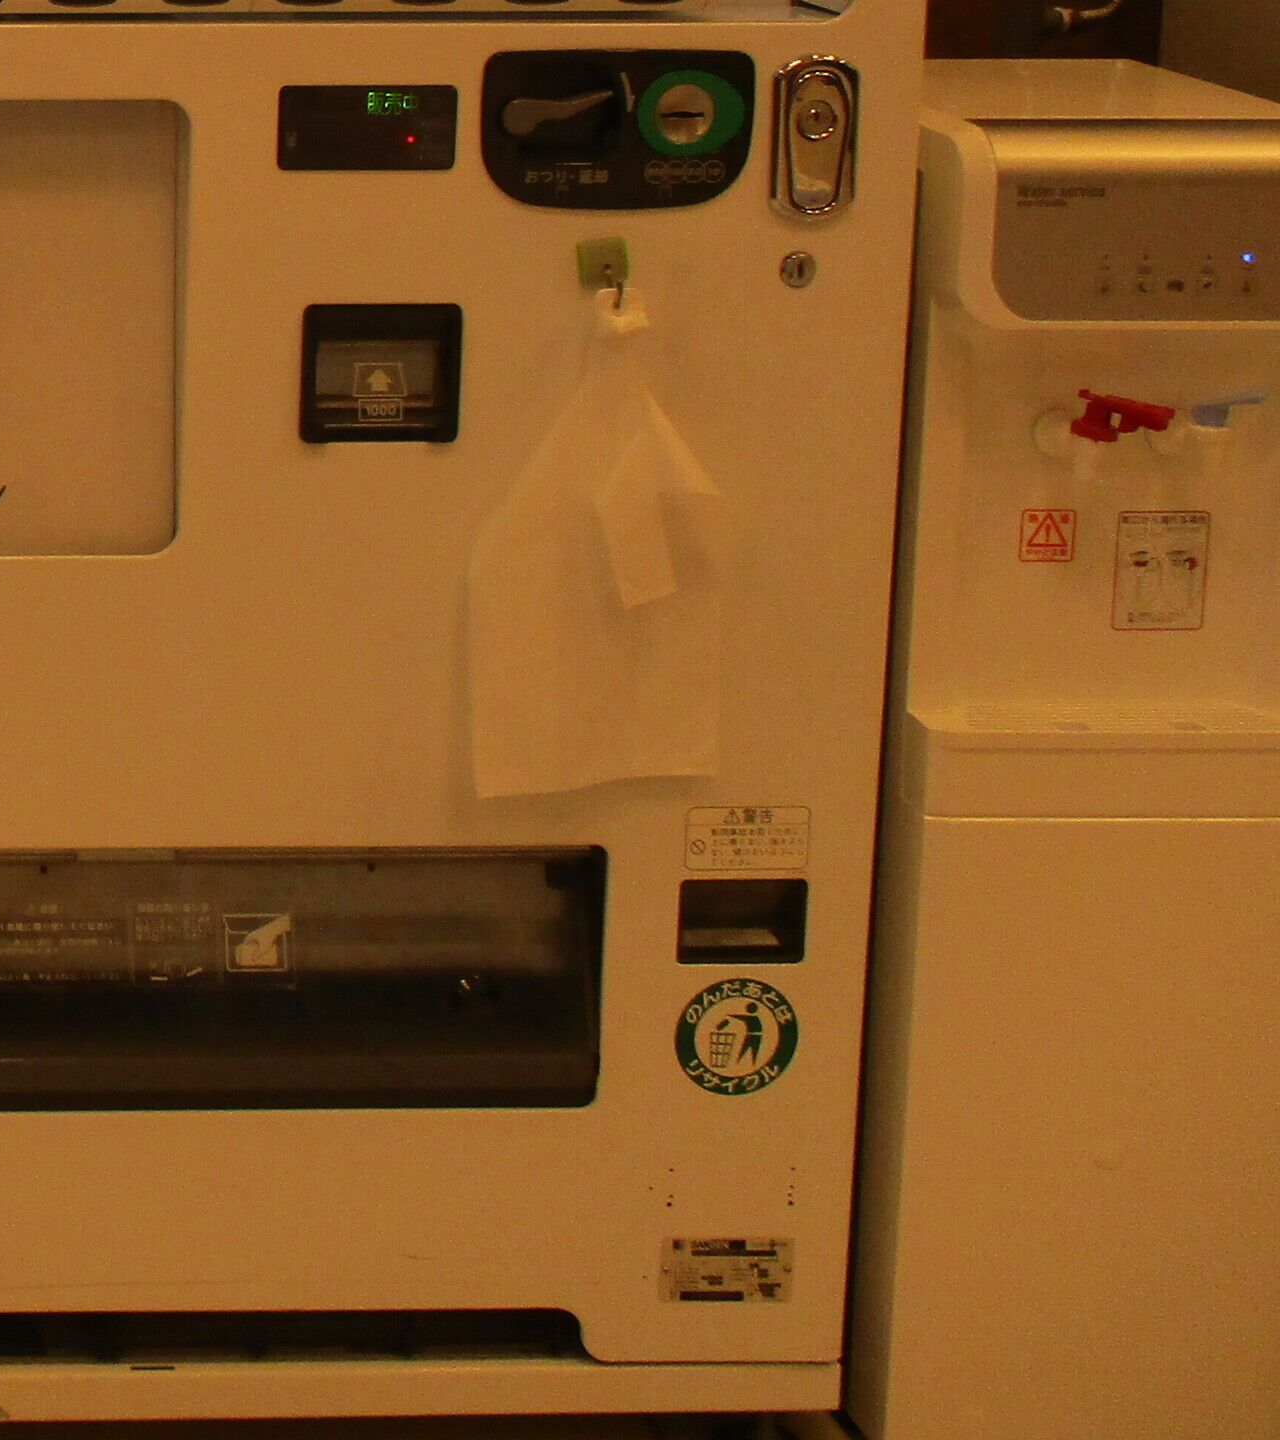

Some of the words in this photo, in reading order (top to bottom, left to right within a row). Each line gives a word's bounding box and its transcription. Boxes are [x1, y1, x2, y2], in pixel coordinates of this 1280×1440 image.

[366, 90, 419, 116] 販売中
[684, 979, 794, 1027] のんだあとは
[687, 1054, 781, 1094] リサイクル
